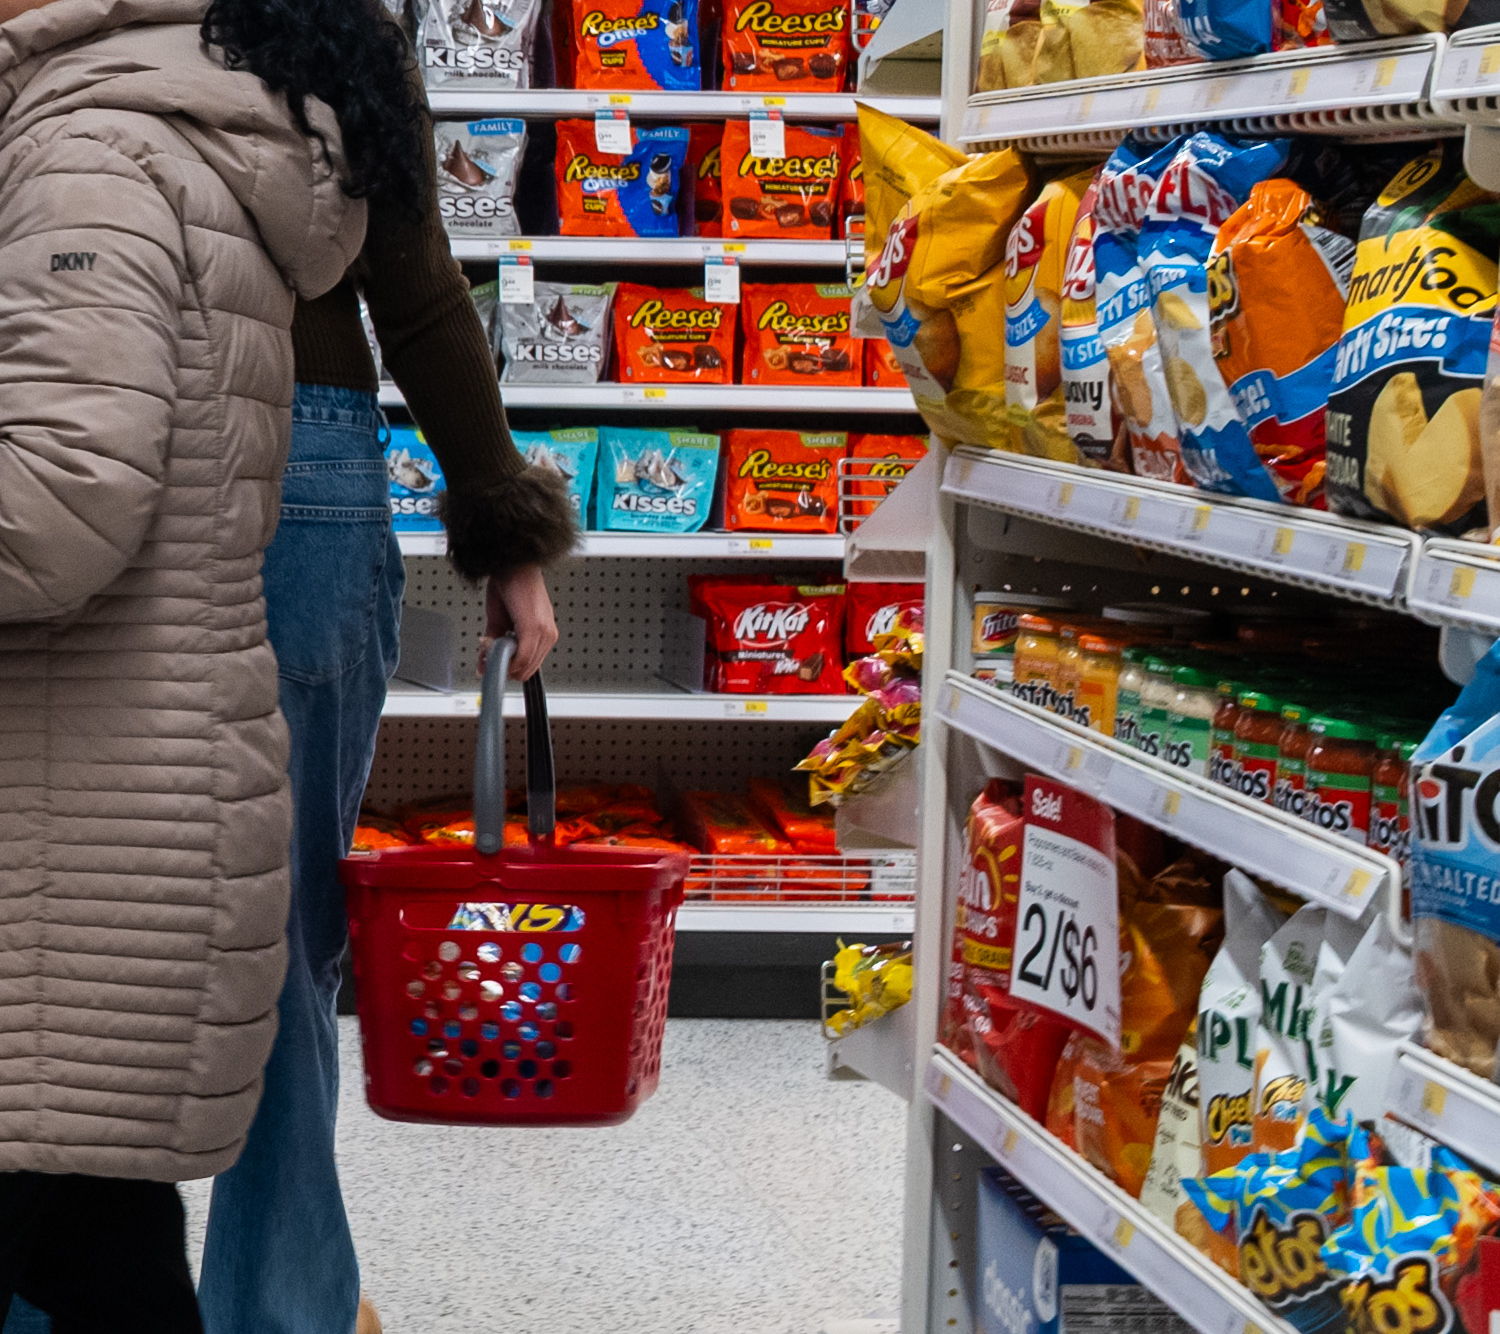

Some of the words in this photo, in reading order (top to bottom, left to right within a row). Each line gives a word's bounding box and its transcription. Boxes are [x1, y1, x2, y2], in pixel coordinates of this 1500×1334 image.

[582, 12, 659, 36] Reese's
[735, 1, 846, 33] Reese's
[425, 47, 525, 68] KISSES
[473, 122, 514, 133] FAMILY
[566, 156, 641, 181] Reese's
[50, 253, 97, 272] DKNY
[632, 301, 722, 330] Reese's
[759, 302, 849, 333] Reese's
[739, 451, 832, 480] Reese's
[613, 494, 697, 516] KISSES
[1032, 788, 1063, 823] Sale!
[1018, 902, 1098, 1012] 2/$6
